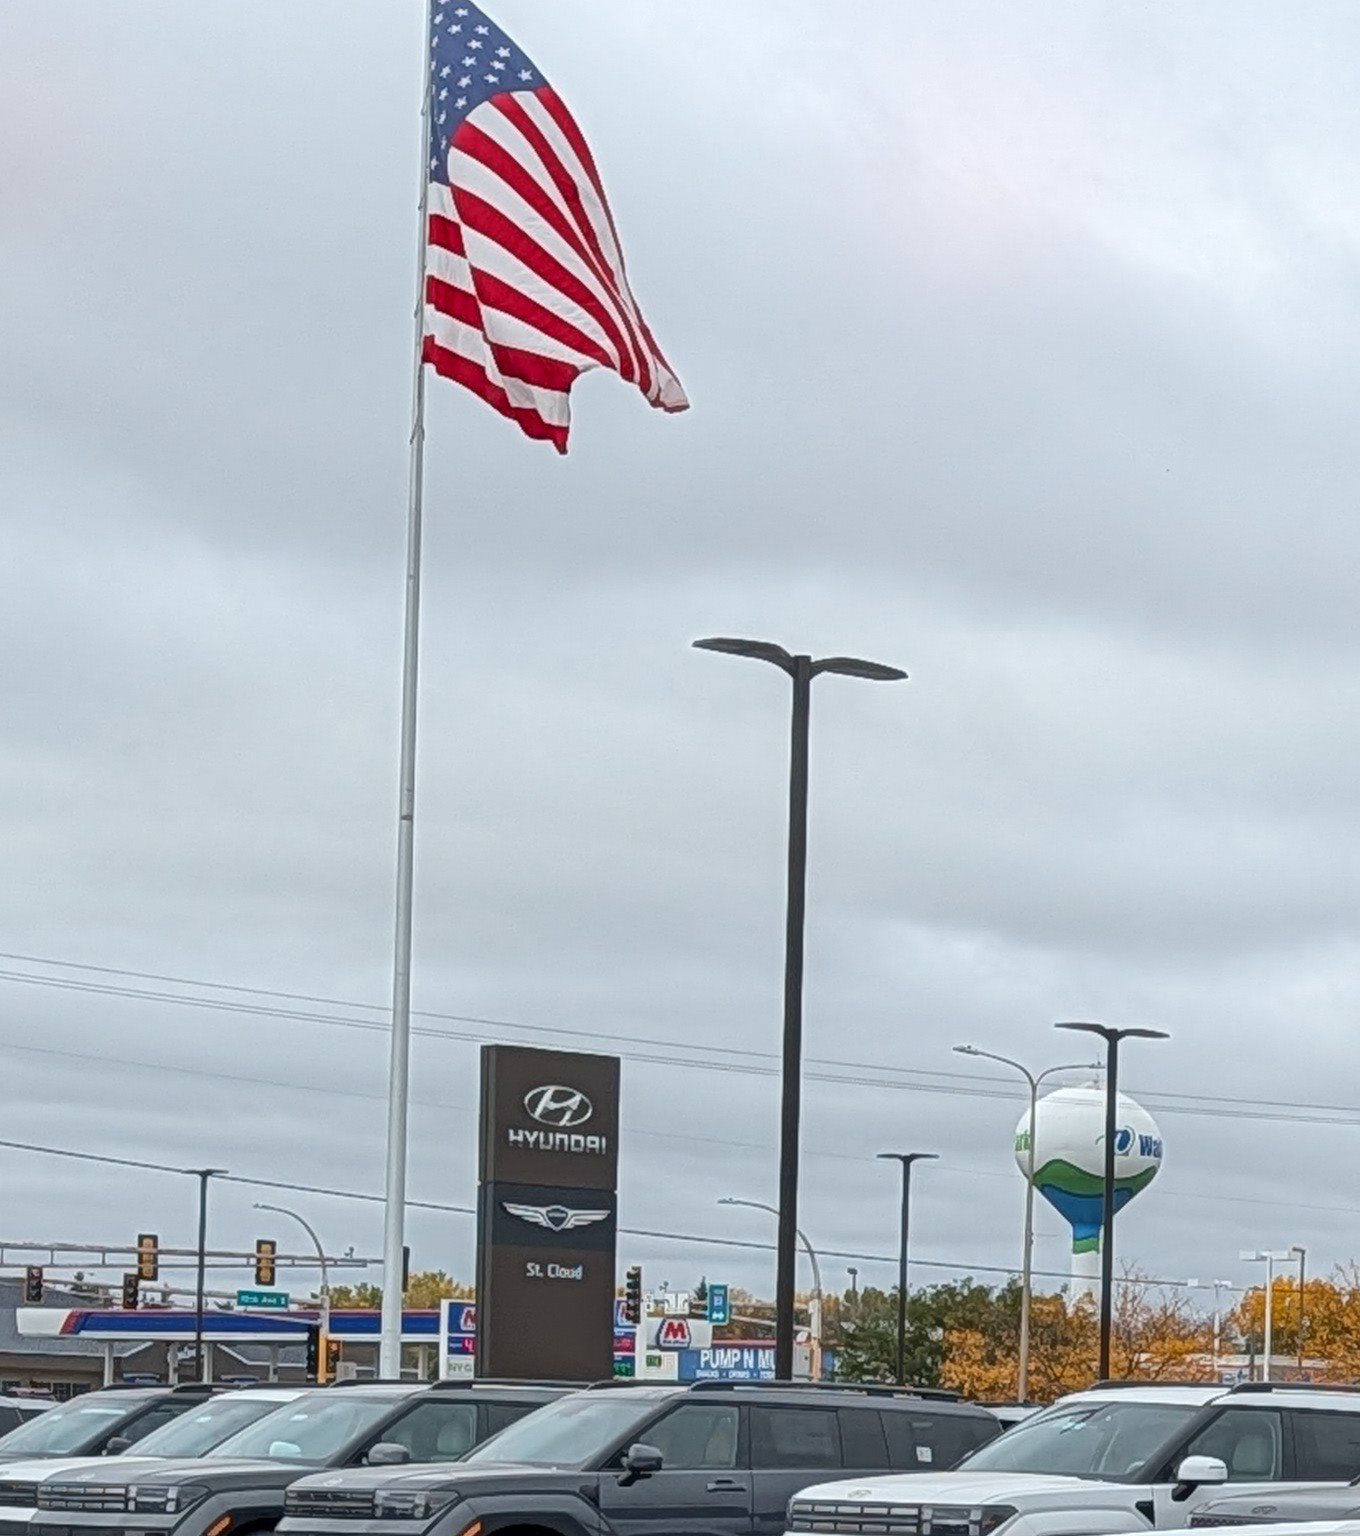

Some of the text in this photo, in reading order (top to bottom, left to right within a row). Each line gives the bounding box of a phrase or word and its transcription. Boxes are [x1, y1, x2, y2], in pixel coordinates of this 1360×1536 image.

[508, 1128, 607, 1155] HYUNDAI
[526, 1262, 583, 1281] St. Cloud
[700, 1348, 741, 1369] PUMP
[743, 1348, 754, 1369] N
